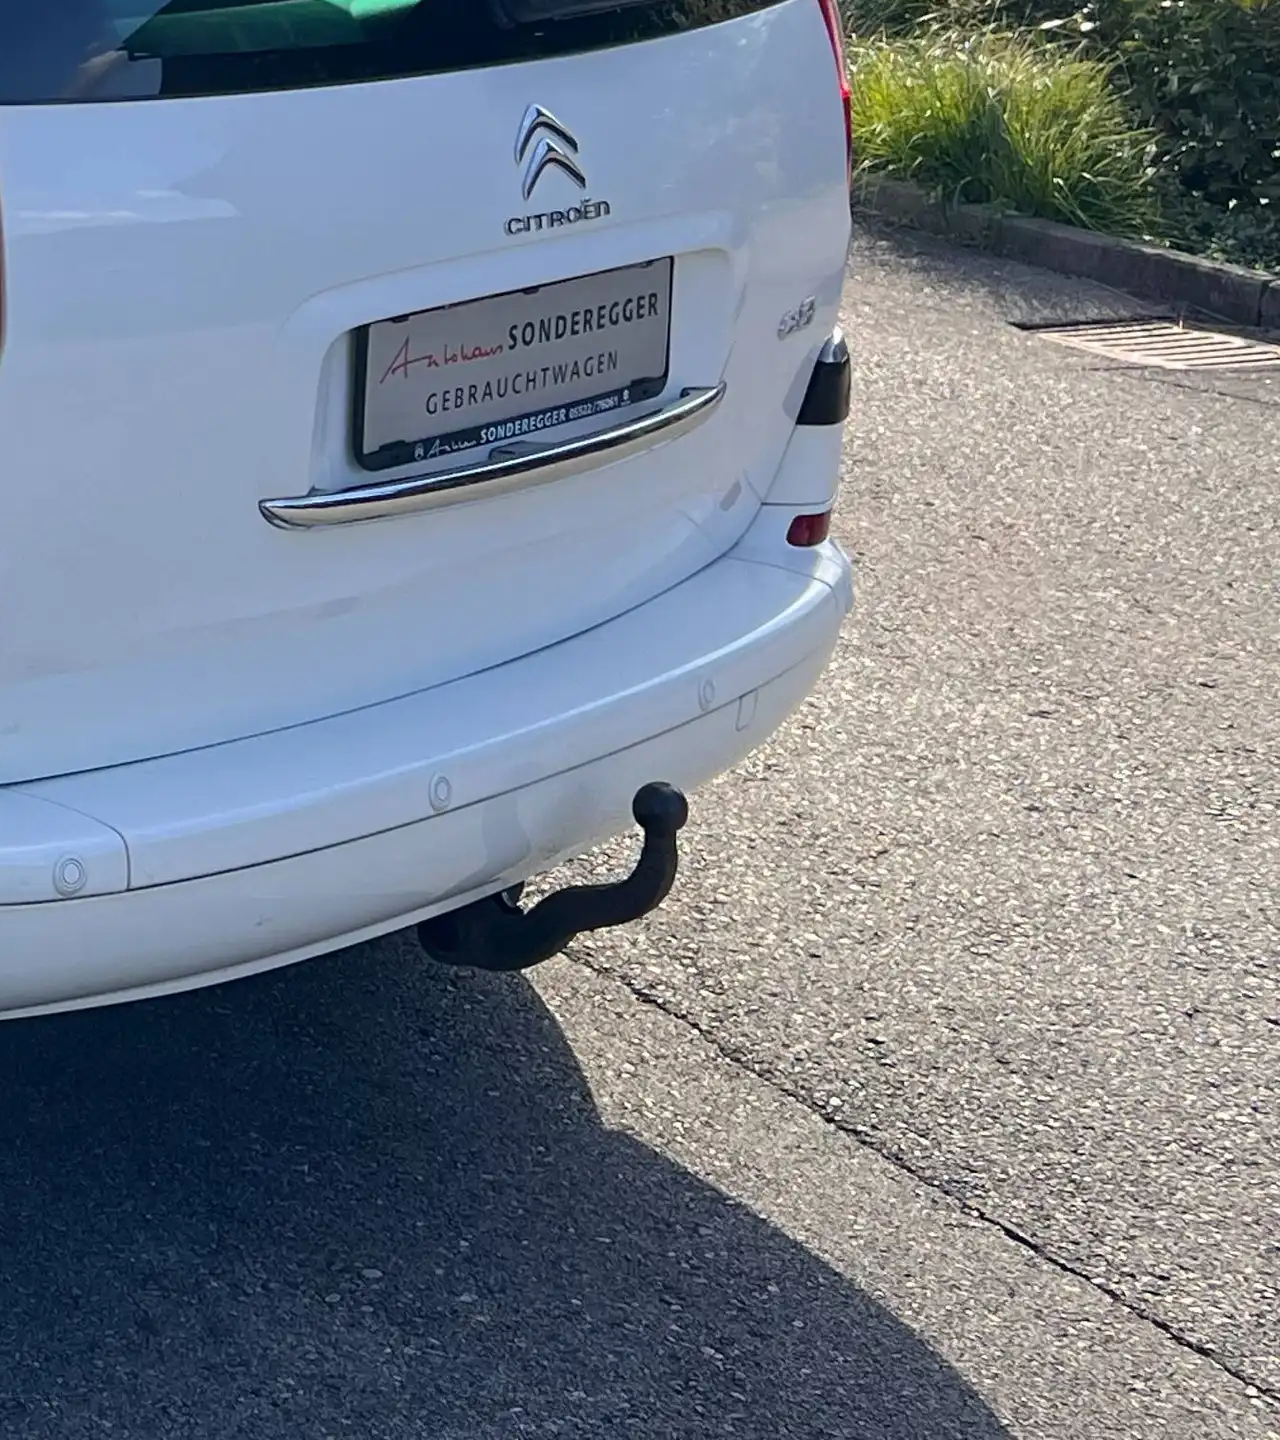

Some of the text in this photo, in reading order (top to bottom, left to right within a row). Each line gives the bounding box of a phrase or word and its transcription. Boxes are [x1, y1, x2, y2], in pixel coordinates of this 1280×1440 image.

[507, 292, 659, 351] SONDEREGGER
[425, 350, 618, 415] GEBRAUCHTWAGEN
[480, 408, 567, 444] SONDEREGGER
